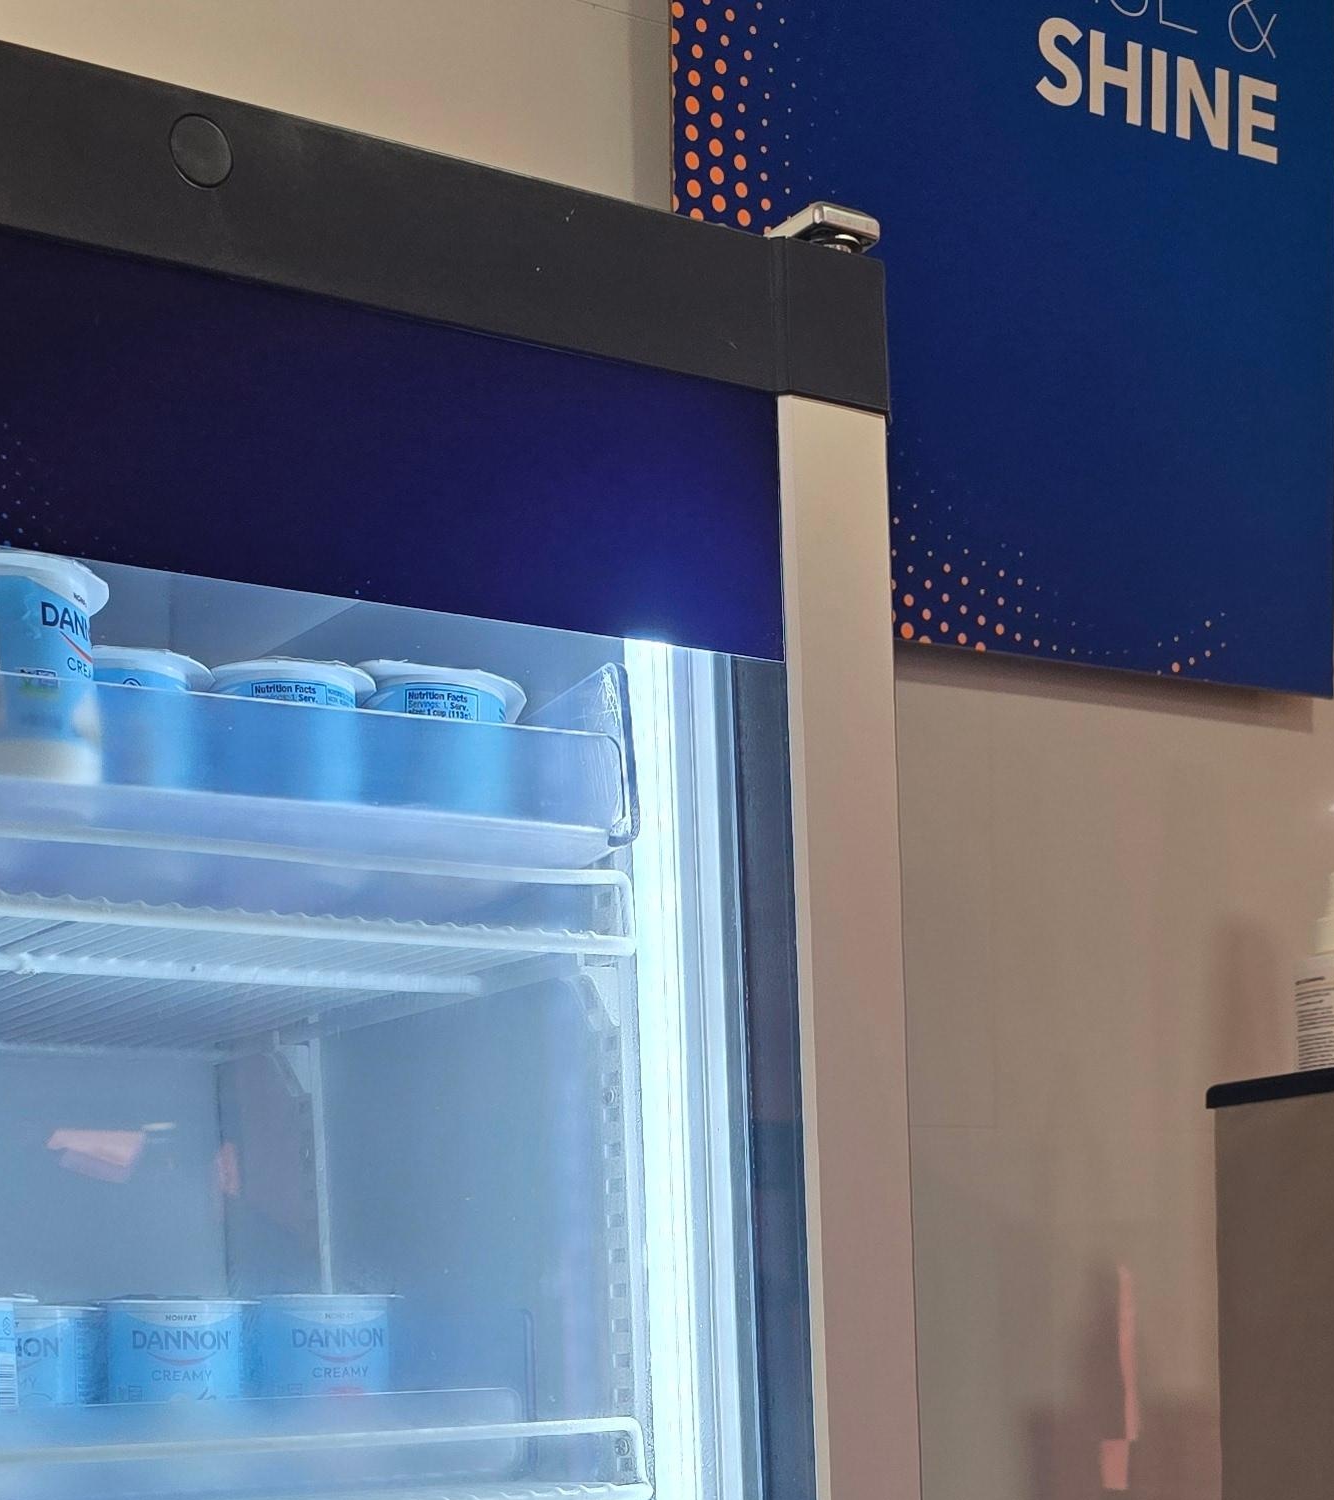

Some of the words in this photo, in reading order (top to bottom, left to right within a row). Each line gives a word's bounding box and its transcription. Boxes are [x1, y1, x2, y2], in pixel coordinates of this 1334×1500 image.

[1035, 17, 1278, 165] SHINE
[255, 683, 292, 695] Nutrition
[295, 684, 317, 696] Facts
[408, 691, 445, 701] Nutrition
[447, 693, 467, 703] Facts
[165, 1314, 197, 1322] NONFAT
[131, 1329, 229, 1351] DANNON
[291, 1328, 385, 1349] DANNON
[151, 1369, 213, 1382] CREAMY
[313, 1366, 369, 1379] CREAMY
